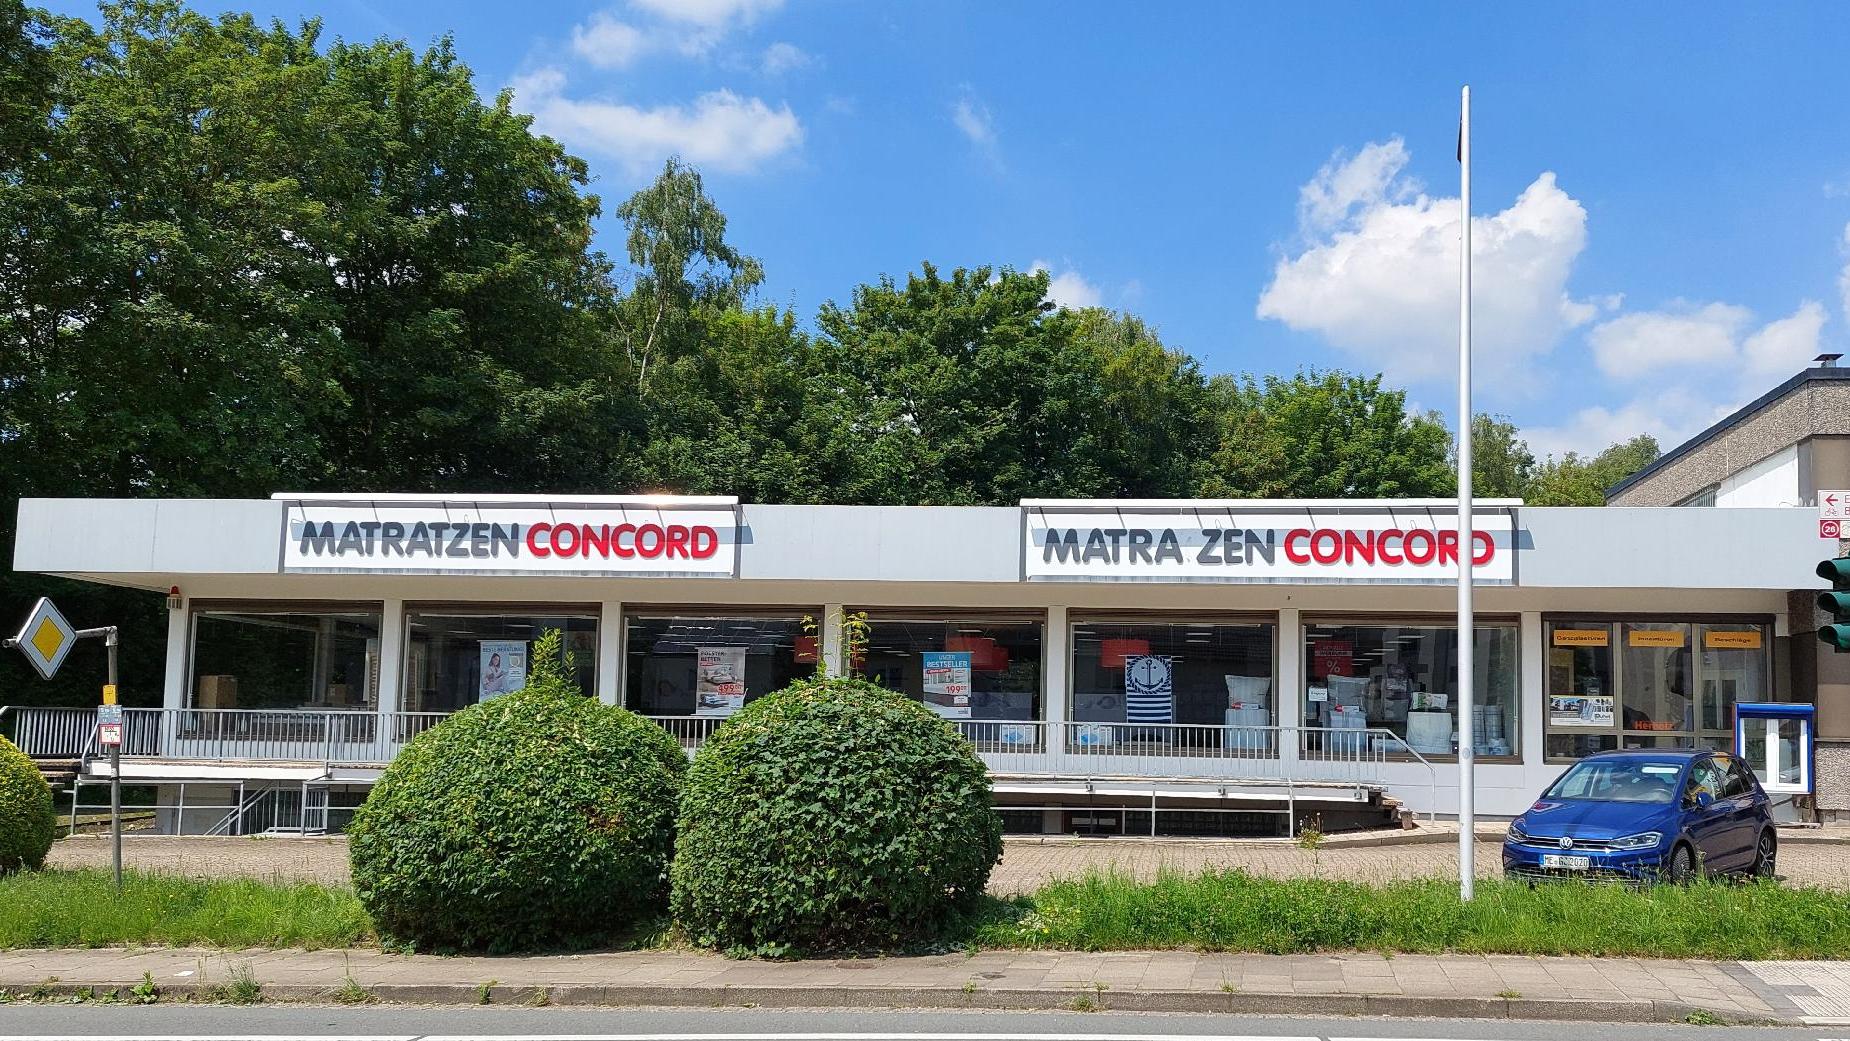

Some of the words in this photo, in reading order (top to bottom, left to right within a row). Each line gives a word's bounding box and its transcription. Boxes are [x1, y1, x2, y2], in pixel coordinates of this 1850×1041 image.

[300, 521, 519, 558] MATRATZEN
[527, 522, 718, 559] CONCORD
[1284, 528, 1495, 566] CONCORD
[926, 660, 968, 668] BESTSELLER
